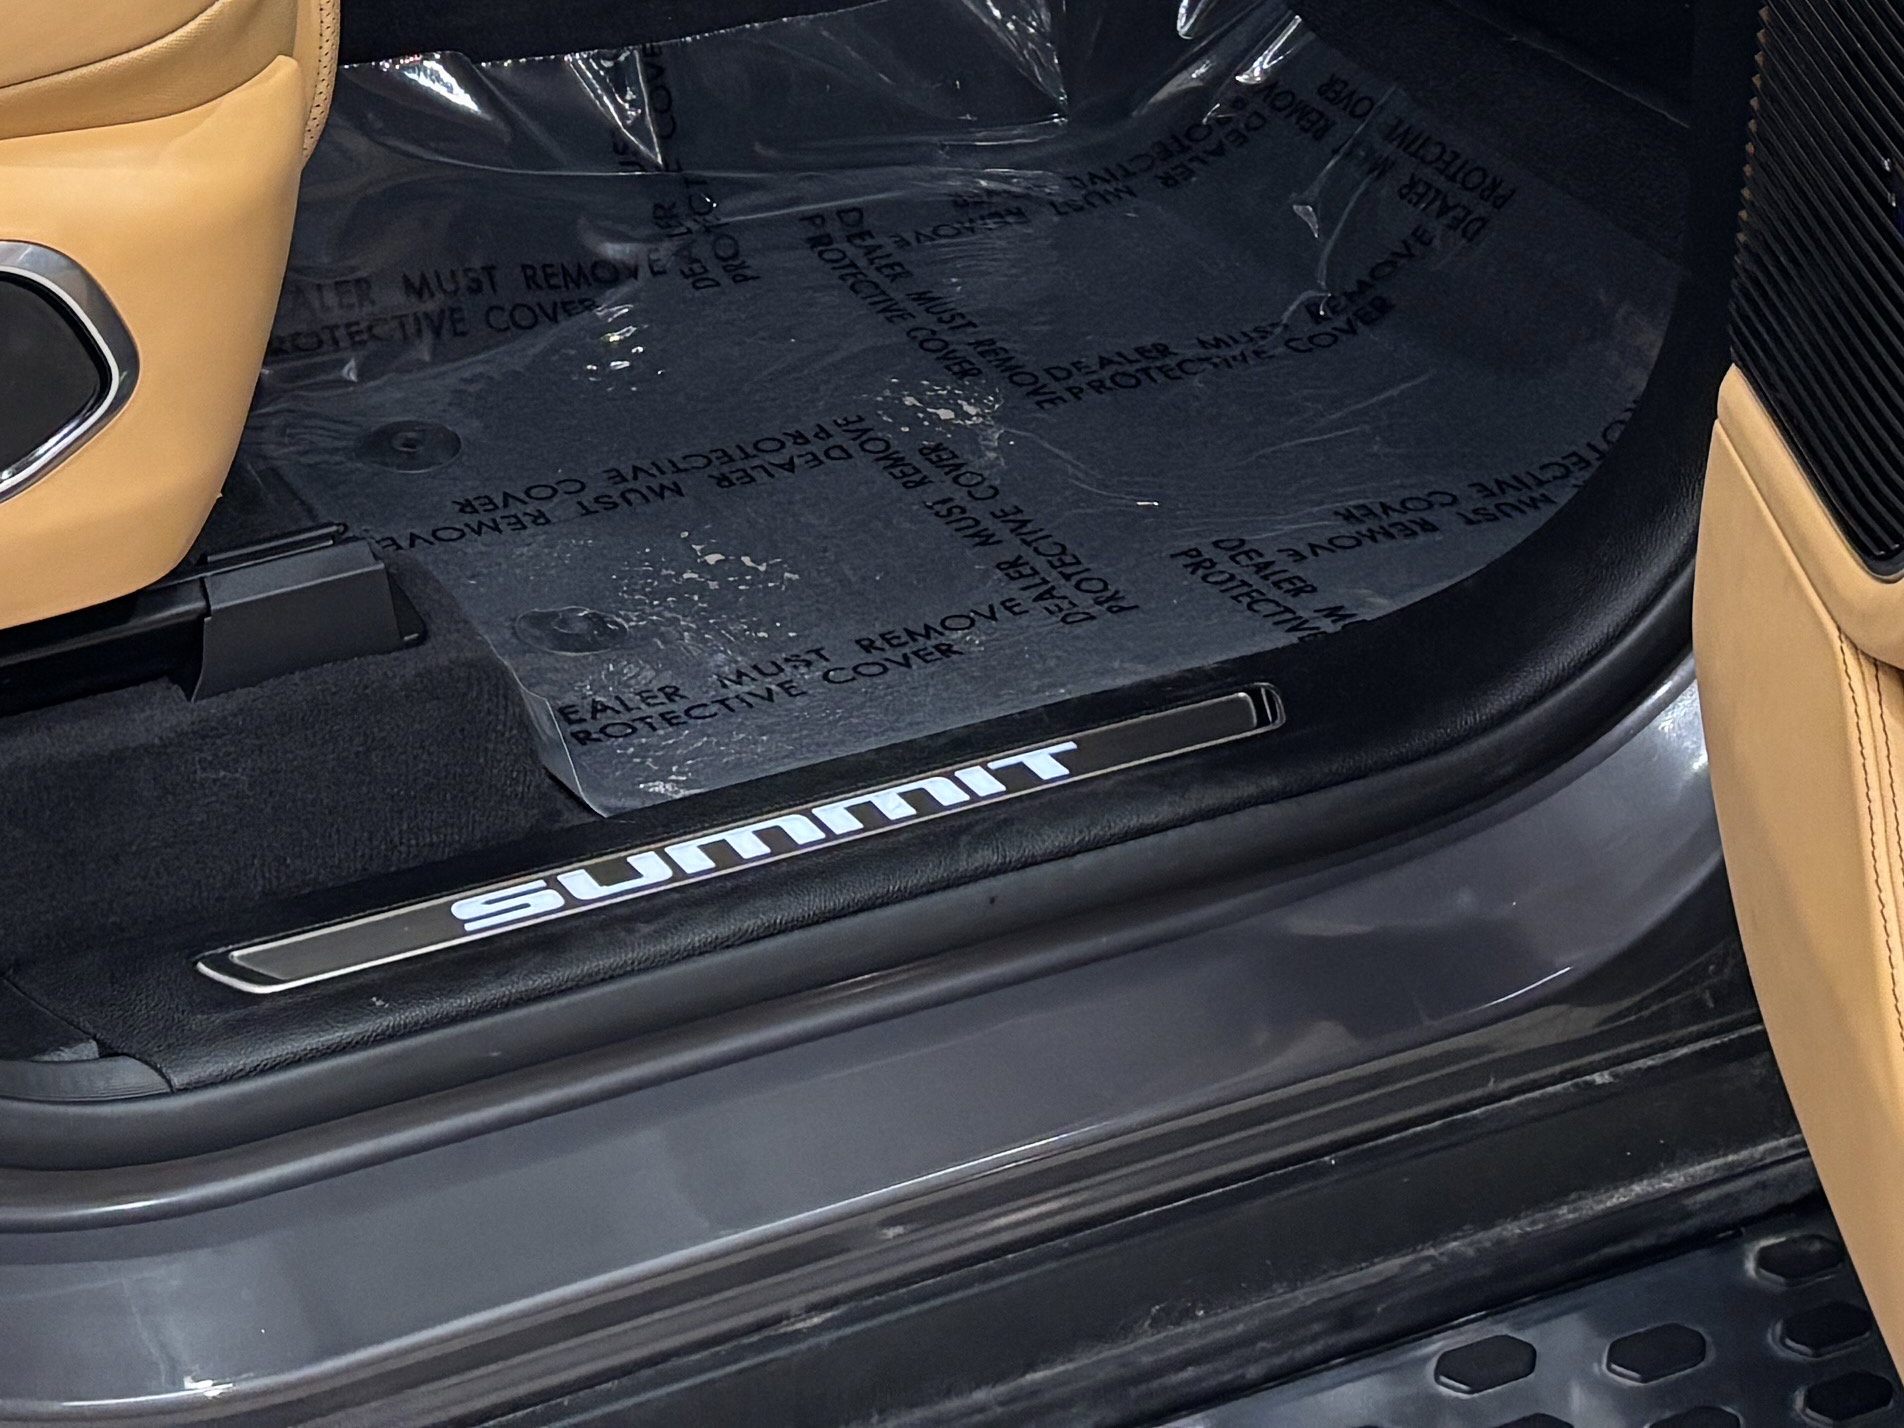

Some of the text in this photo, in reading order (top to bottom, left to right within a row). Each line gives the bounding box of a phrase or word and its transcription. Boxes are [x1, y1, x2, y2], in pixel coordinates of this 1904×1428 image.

[1316, 73, 1384, 121] OVER
[402, 265, 498, 301] MUST
[836, 207, 1068, 411] DEALER MUST REMOVE
[485, 297, 597, 334] COVER
[1284, 295, 1395, 354] COVER
[906, 326, 984, 380] COVER
[1044, 341, 1179, 383] DEALER
[377, 443, 854, 553] DEALER MUST REMOVE
[452, 423, 833, 515] PROTECTIVE COVER
[833, 415, 1097, 626] DEALER MUST REMOVE
[918, 442, 1140, 616] PROTECTIVE COVER
[1334, 490, 1458, 524] COVER
[1212, 537, 1319, 598] DEALER
[1277, 516, 1439, 563] REMOVE
[717, 645, 832, 691] MUST
[855, 597, 1030, 655] REMOVE
[822, 641, 964, 685] COVER
[450, 740, 1078, 933] SUMMIT
